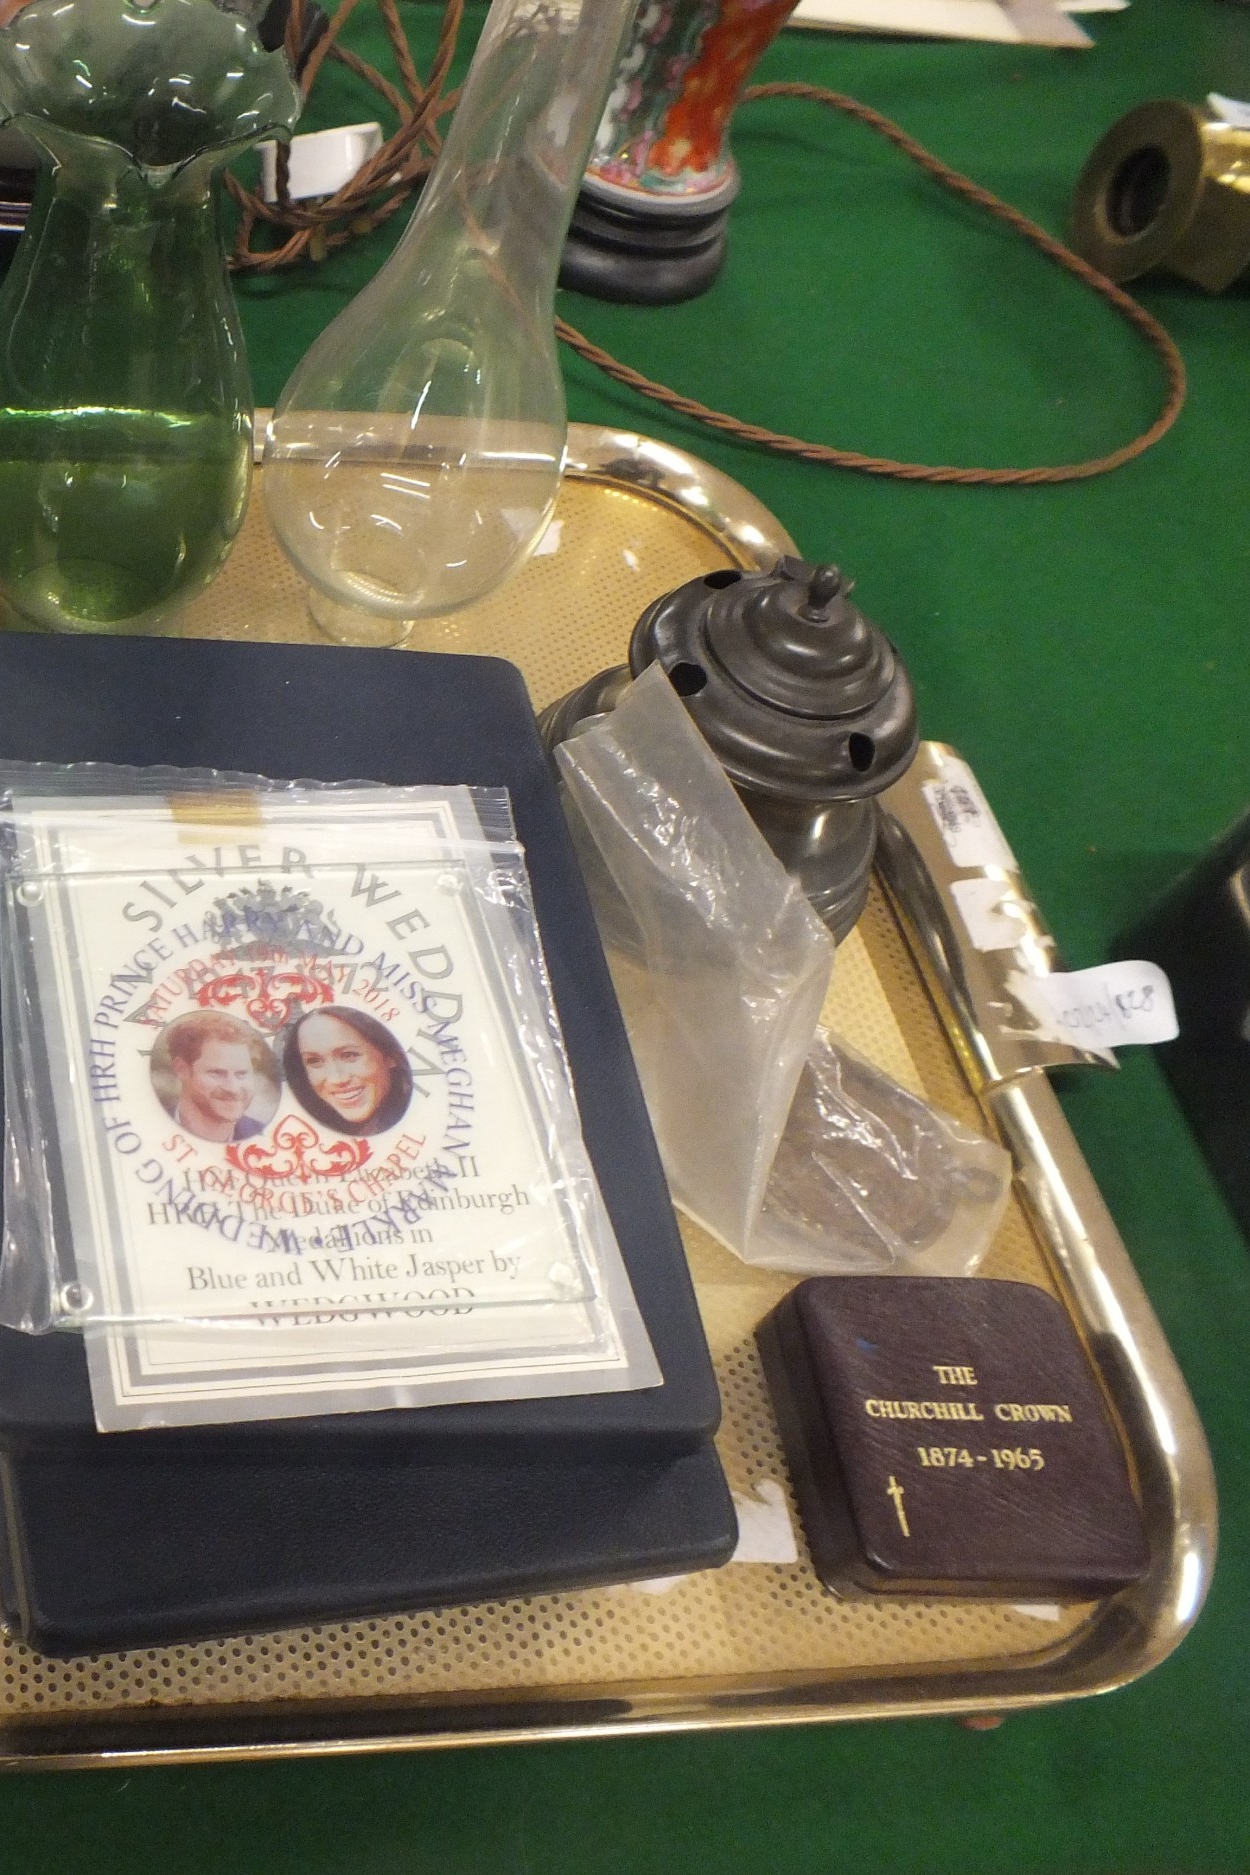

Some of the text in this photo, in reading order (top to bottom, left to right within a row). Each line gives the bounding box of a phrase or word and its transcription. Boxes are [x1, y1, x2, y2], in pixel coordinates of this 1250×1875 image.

[122, 844, 315, 933] SILVER
[94, 937, 175, 1030] PRINCE
[299, 950, 351, 983] MAY
[352, 978, 401, 1021] 2018
[372, 951, 431, 1014] MISS
[89, 1038, 121, 1103] HRH
[427, 1020, 476, 1159] MEGHAN
[103, 1116, 142, 1155] OF
[162, 1133, 198, 1163] ST
[347, 1133, 428, 1204] CHAPEL
[458, 1155, 481, 1178] II
[368, 1189, 397, 1213] of
[396, 1183, 531, 1215] Edinburgh
[412, 1227, 435, 1244] in
[187, 1250, 522, 1291] Blue and White Jasper by
[932, 1365, 978, 1386] THE
[864, 1399, 1073, 1423] CHURCHILL CROWN
